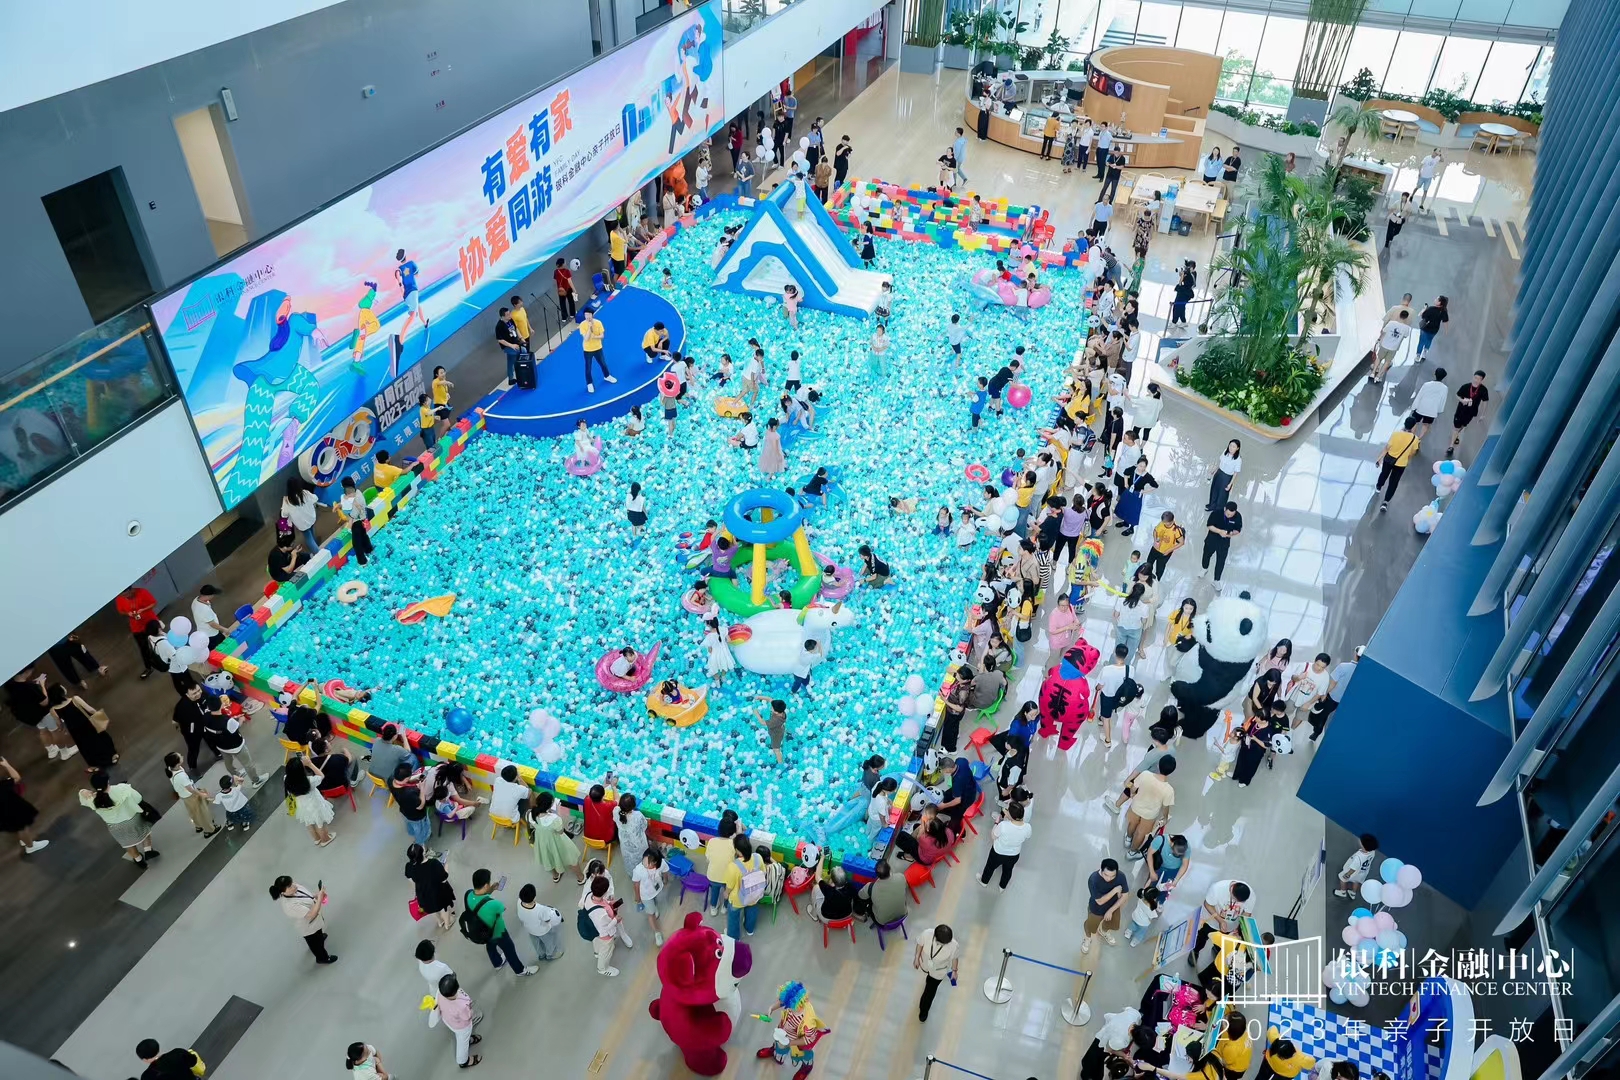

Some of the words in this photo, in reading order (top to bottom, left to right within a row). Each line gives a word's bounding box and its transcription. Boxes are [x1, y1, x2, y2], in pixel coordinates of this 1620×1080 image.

[481, 88, 573, 205] 有爱有家
[555, 123, 621, 192] 银科金融中心亲子开放日
[458, 165, 554, 292] 协爱同游
